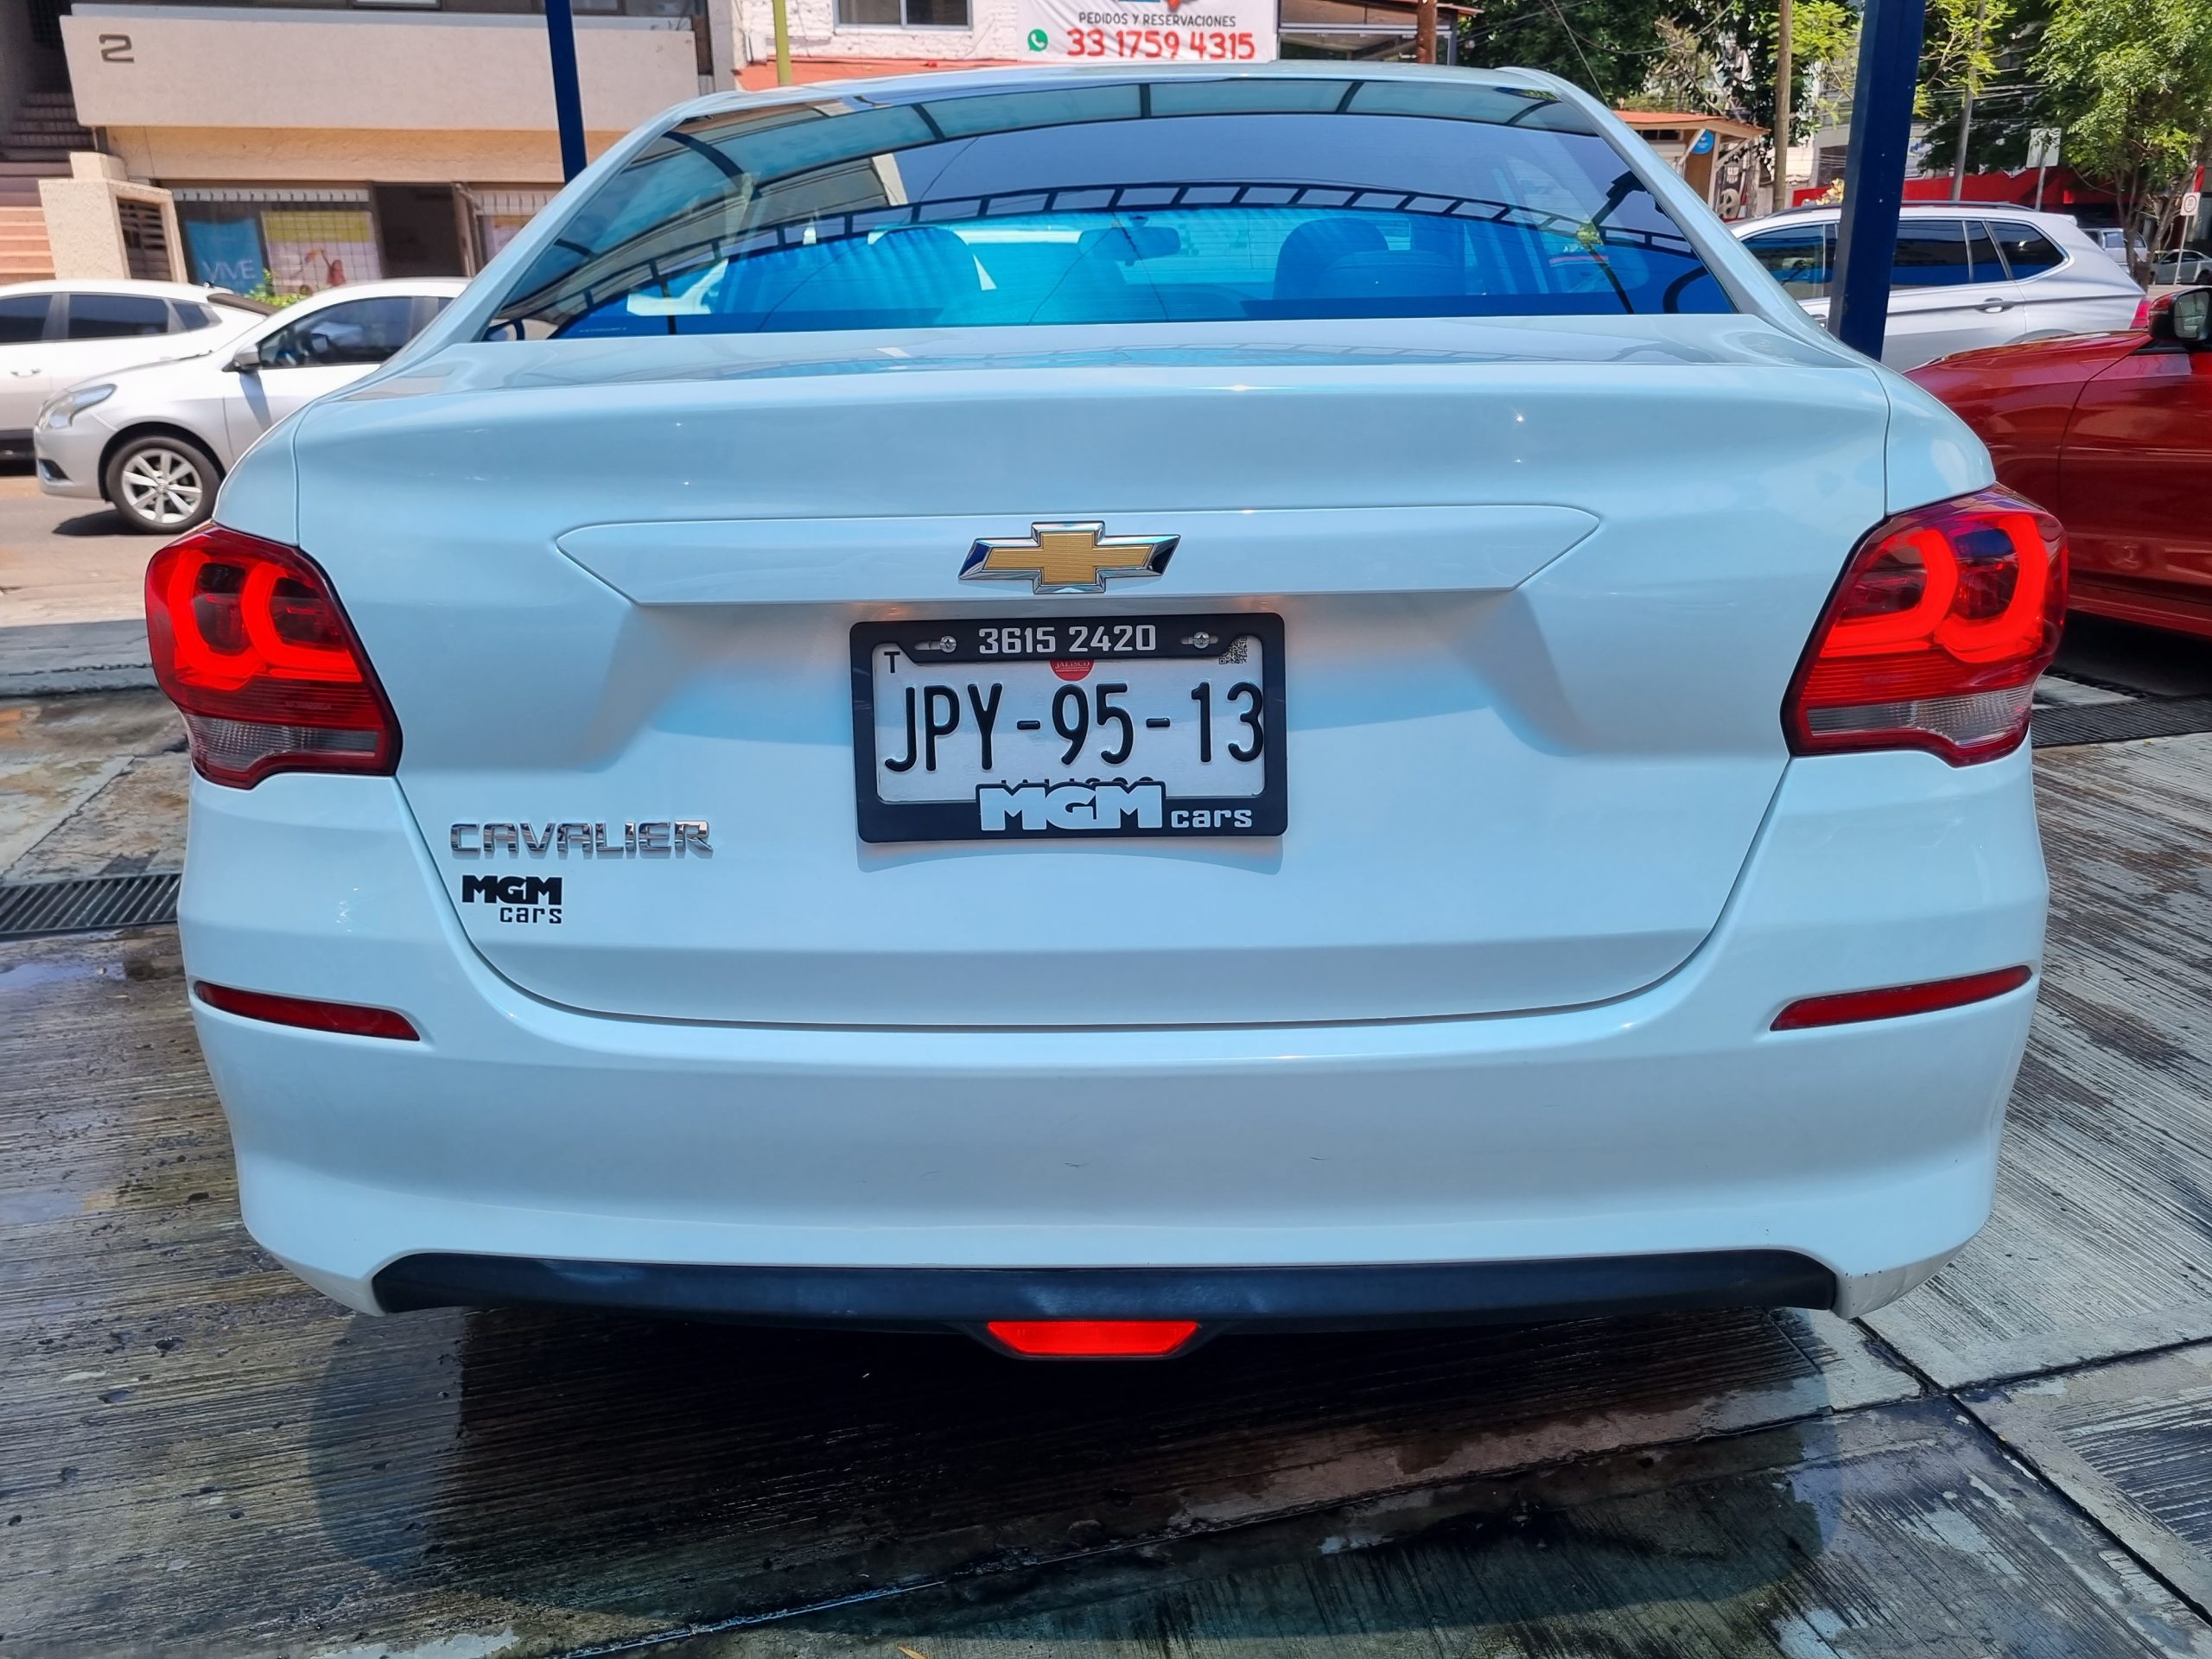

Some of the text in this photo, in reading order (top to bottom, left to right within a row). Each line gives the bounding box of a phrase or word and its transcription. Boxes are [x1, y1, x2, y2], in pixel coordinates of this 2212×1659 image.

[1079, 12, 1236, 27] PEDIDOS Y RESERVACIONES
[99, 34, 135, 63] 2
[1066, 28, 1255, 60] 33 1759 4315
[202, 258, 257, 281] VIVE
[979, 625, 1156, 654] 3615 2420
[884, 651, 901, 673] T
[884, 682, 1264, 772] JPY-95-13
[980, 785, 1252, 831] MGM cars
[450, 820, 714, 854] CAVALIER
[461, 874, 563, 906] MGM
[499, 906, 563, 925] cars
